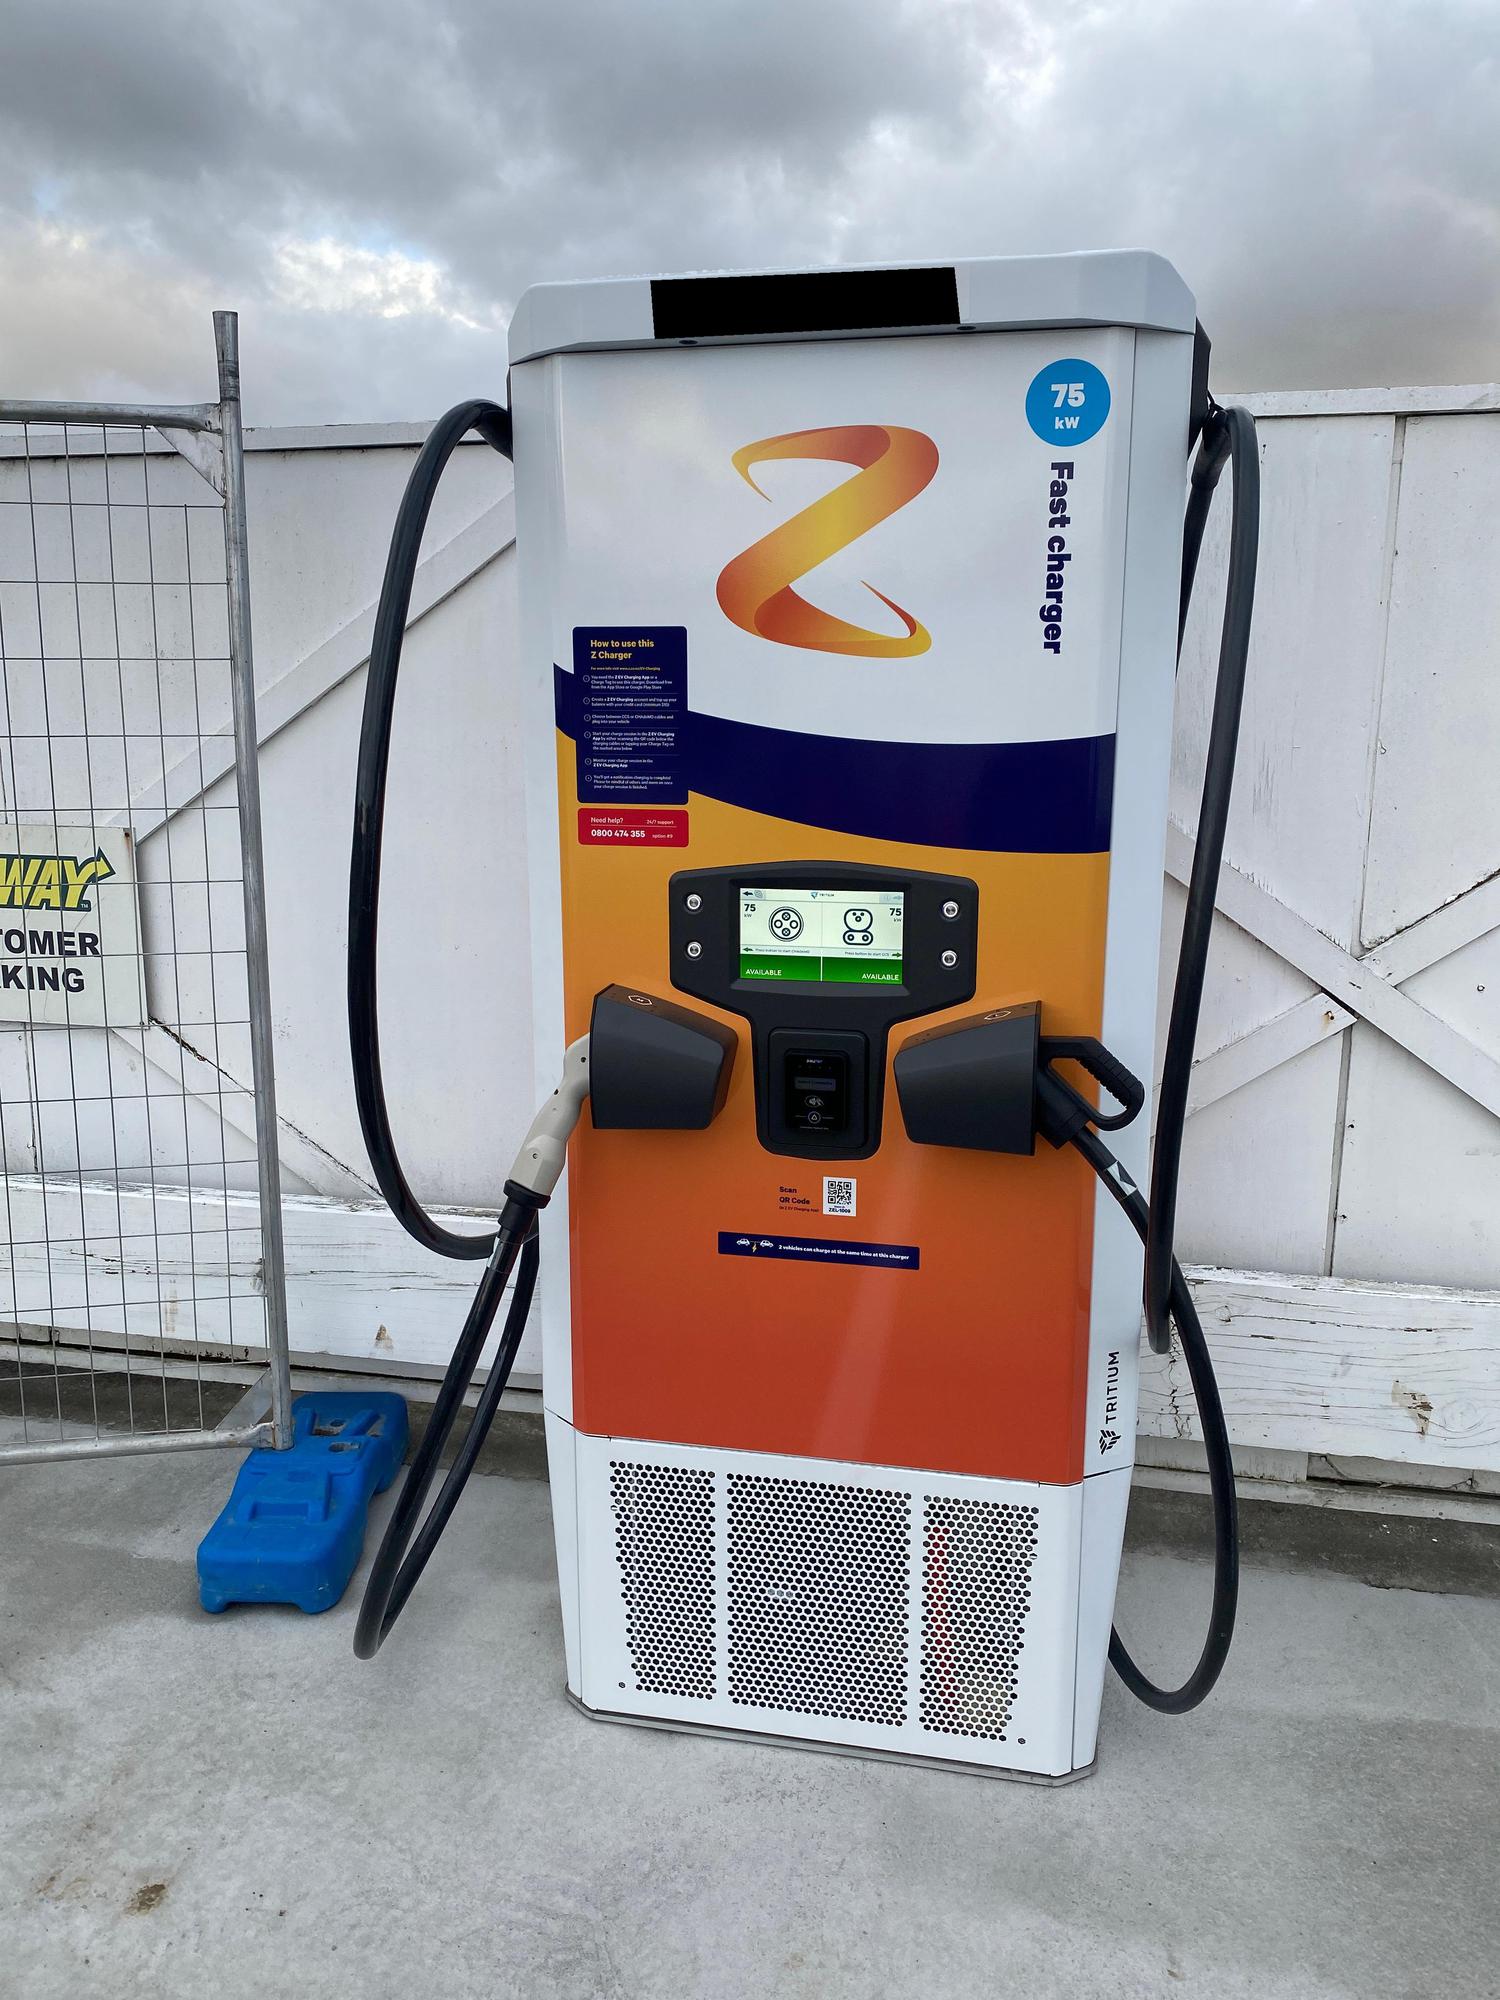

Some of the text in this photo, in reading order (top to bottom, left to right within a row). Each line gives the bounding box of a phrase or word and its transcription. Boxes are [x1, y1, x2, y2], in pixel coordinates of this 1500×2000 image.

[1051, 383, 1085, 408] 75
[1054, 416, 1080, 430] kW
[1039, 462, 1074, 654] Fast charger
[598, 651, 632, 660] Charger
[890, 908, 902, 916] 75
[0, 964, 84, 992] KING
[1106, 1351, 1120, 1424] TRITIUM
